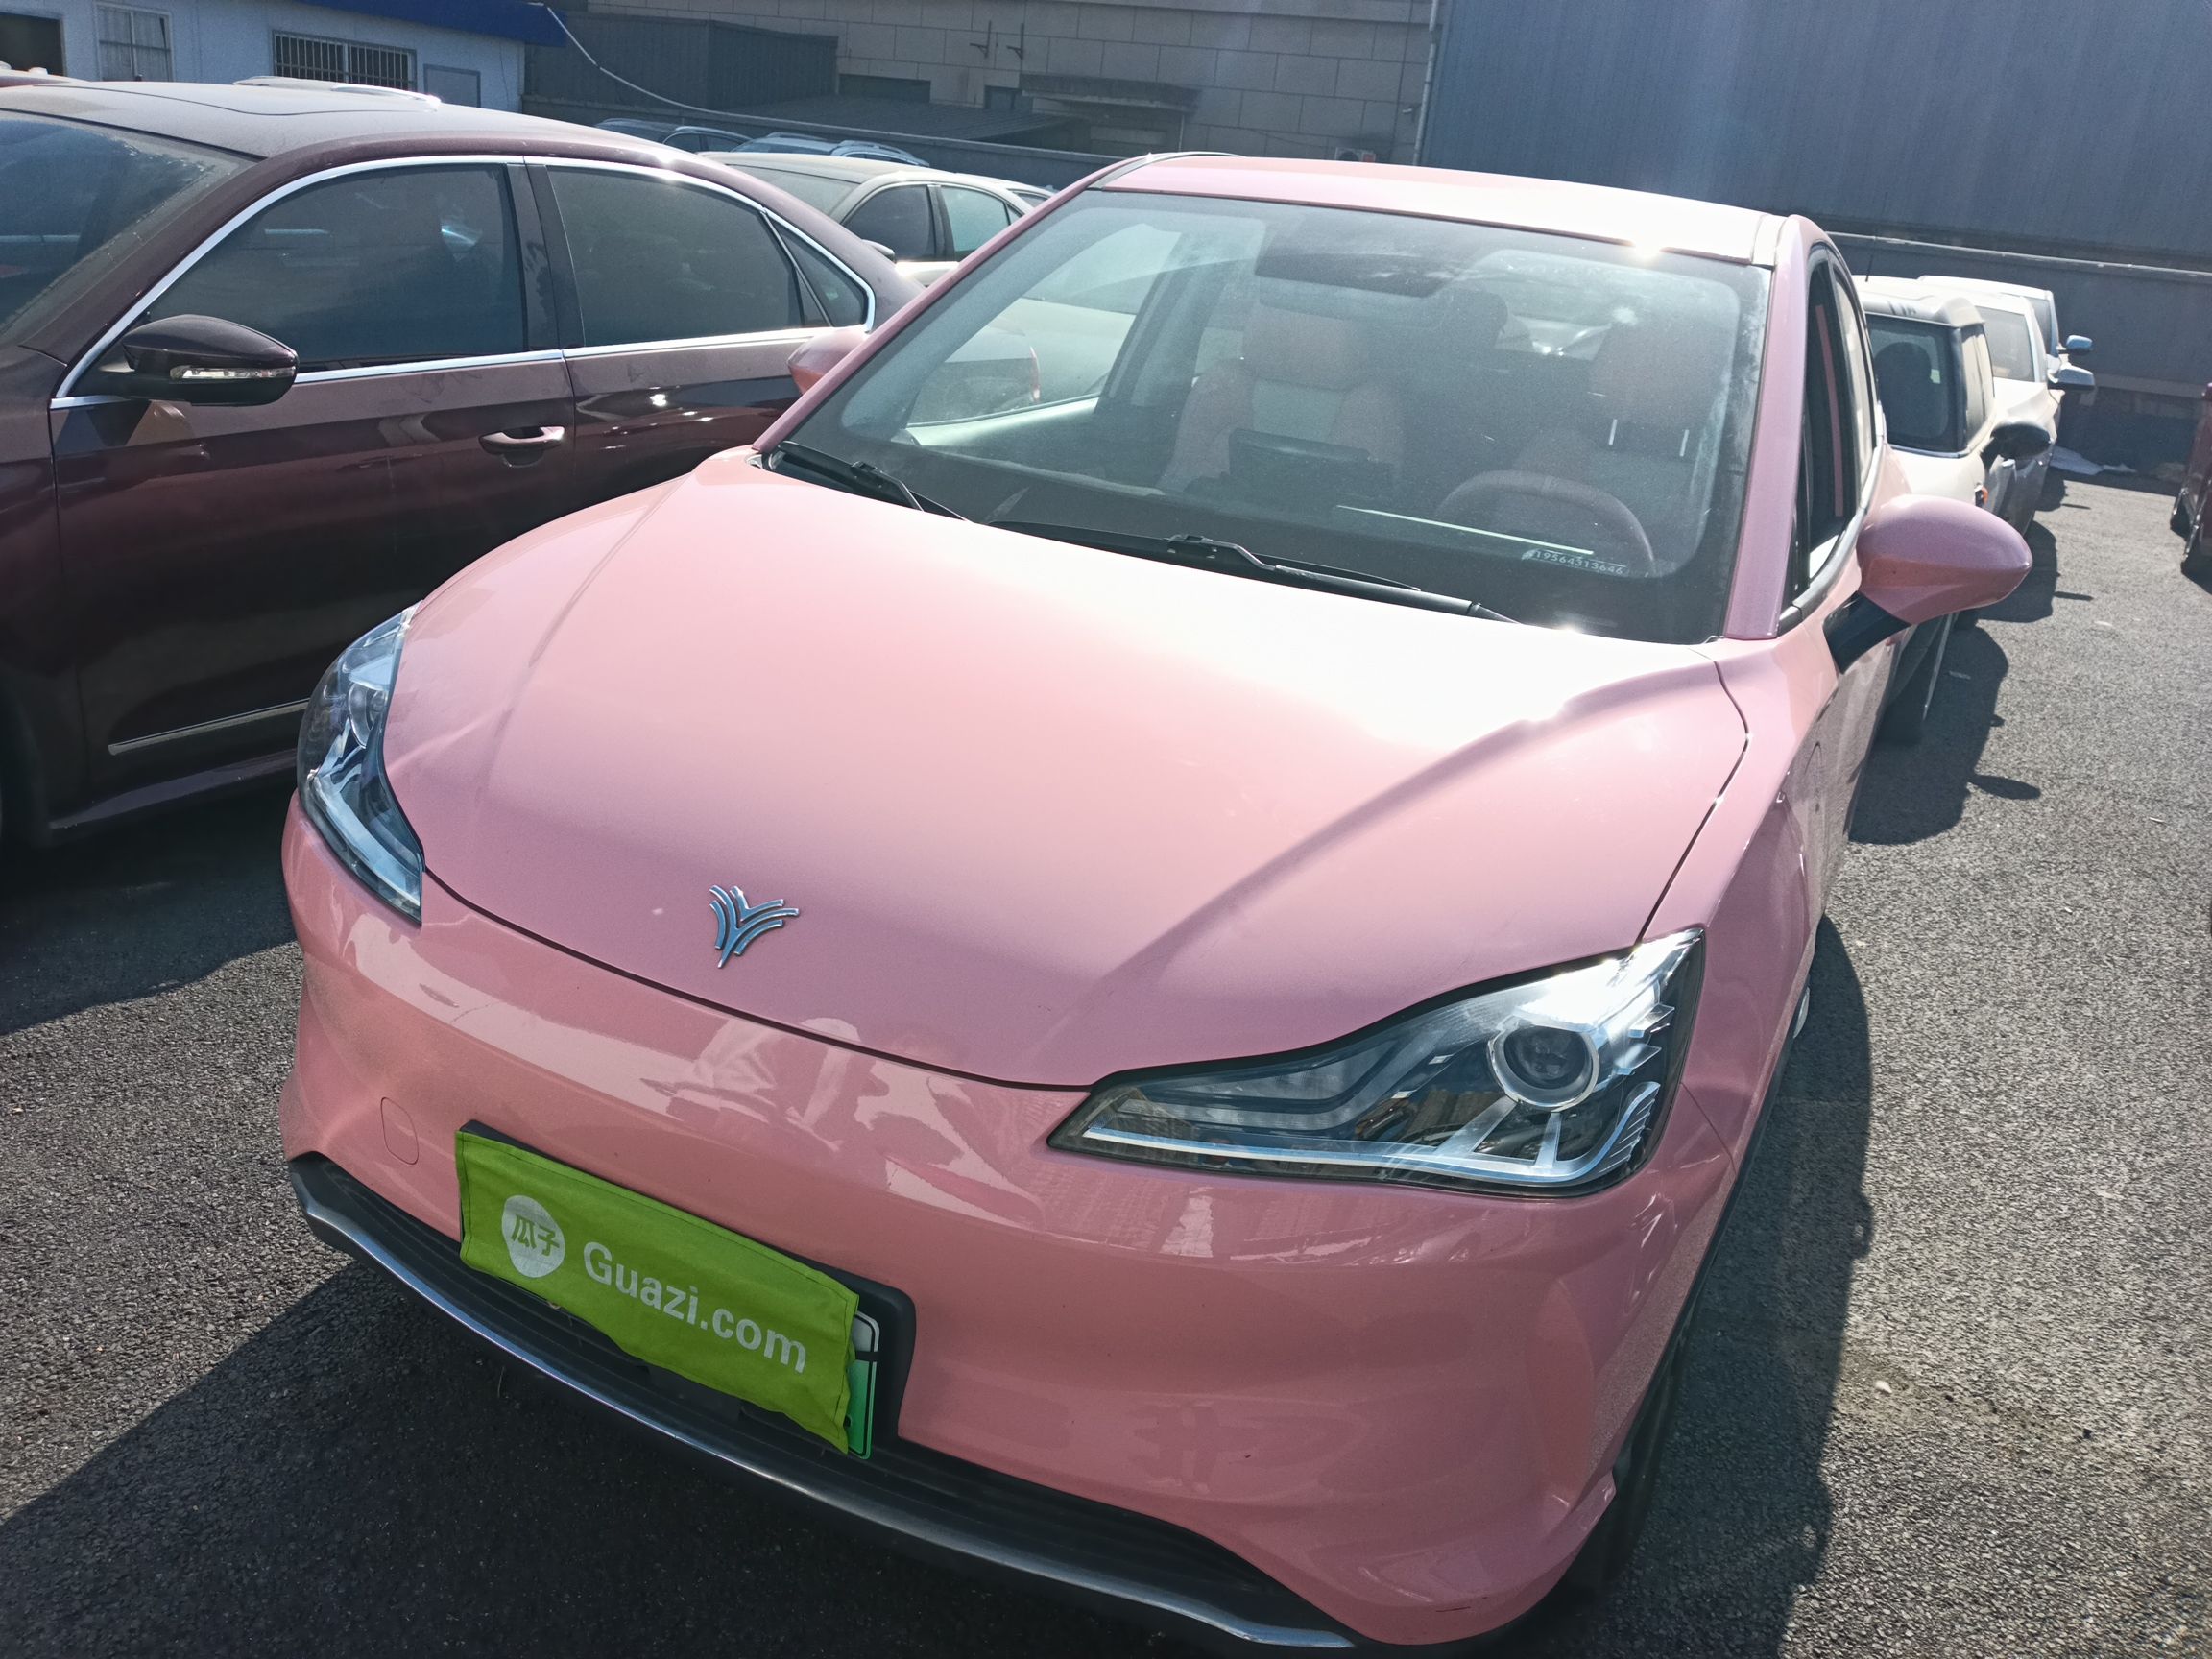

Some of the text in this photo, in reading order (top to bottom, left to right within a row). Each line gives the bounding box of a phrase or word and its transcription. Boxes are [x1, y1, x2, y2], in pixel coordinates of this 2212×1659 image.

[1536, 551, 1623, 574] 19564313646
[511, 1216, 560, 1257] 瓜子
[583, 1242, 806, 1374] Guazi.com
